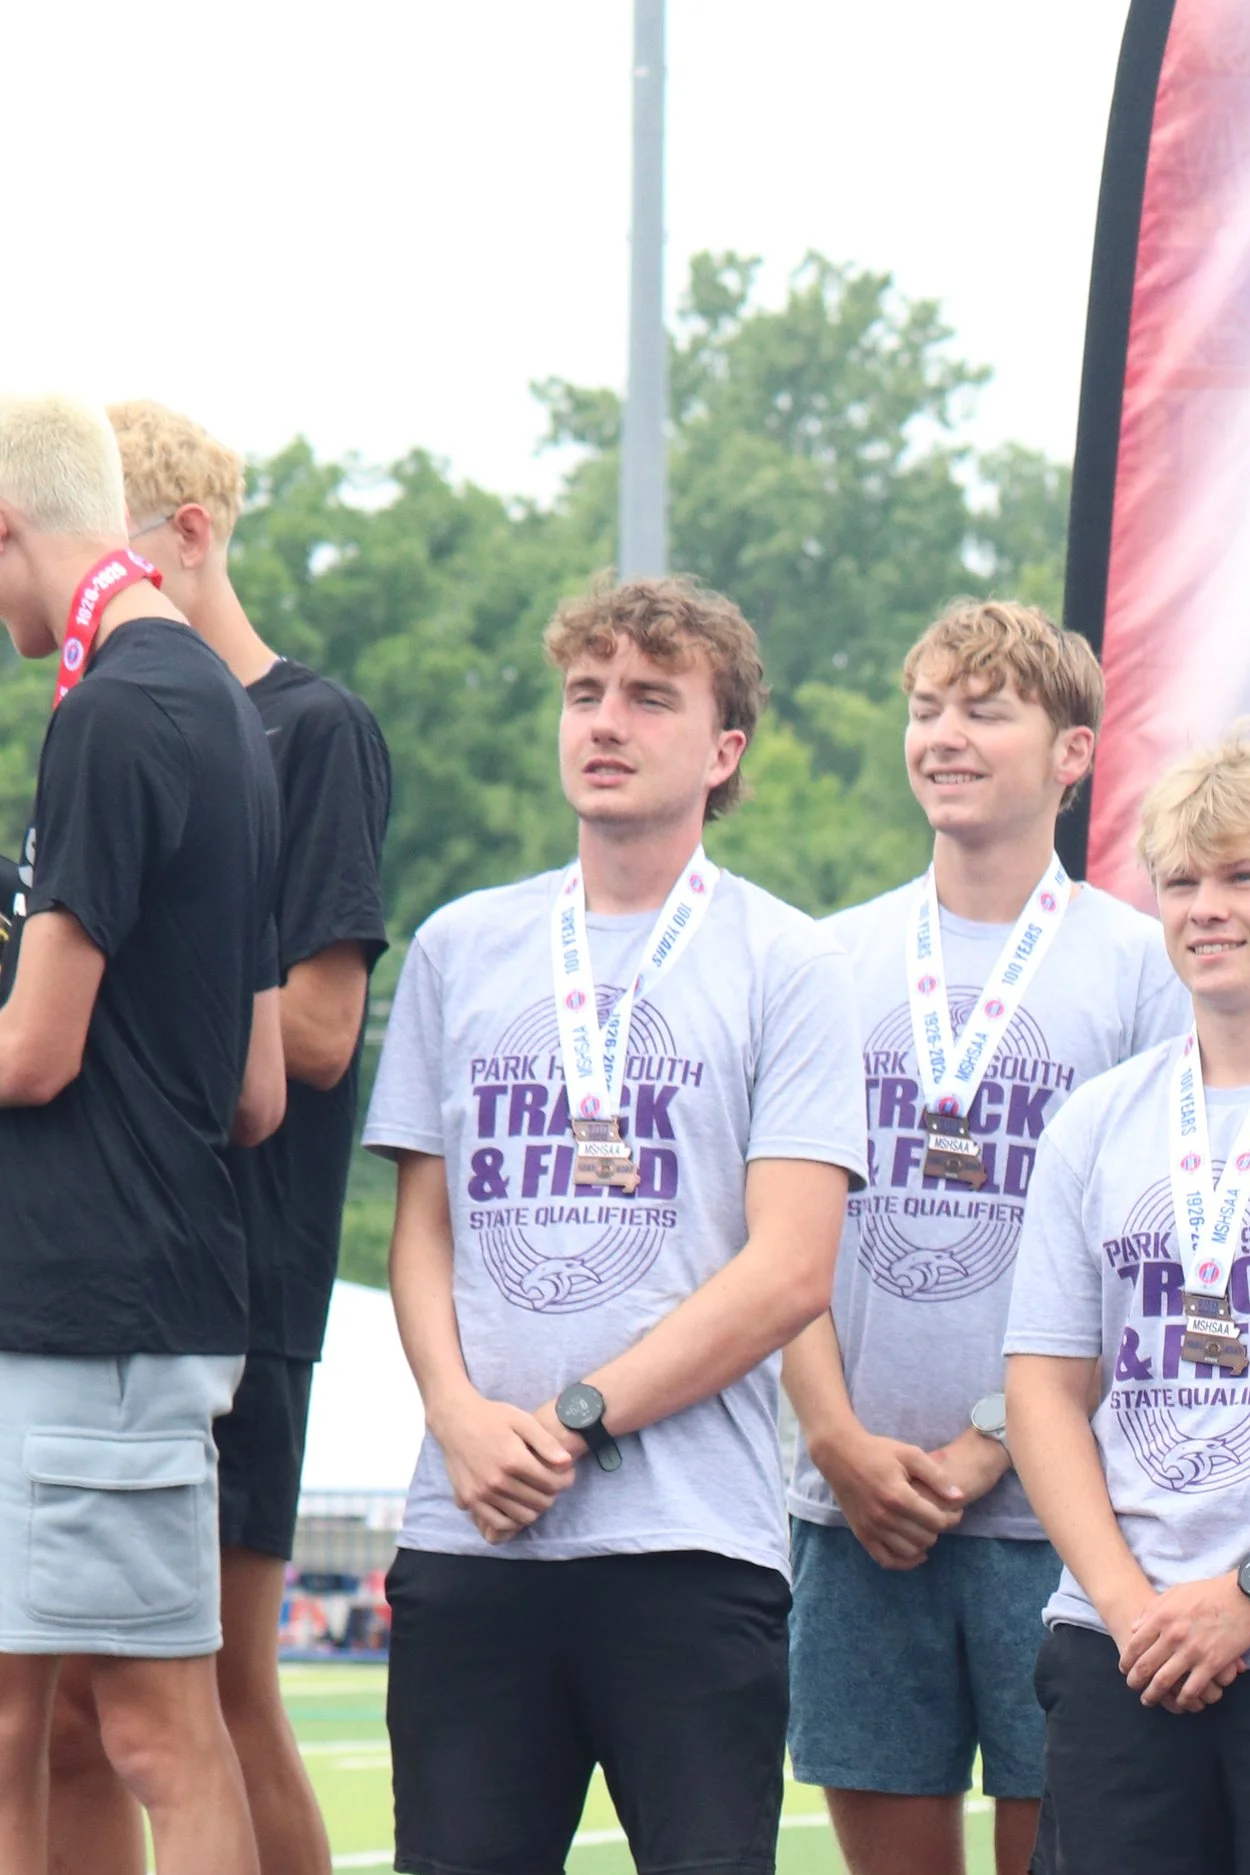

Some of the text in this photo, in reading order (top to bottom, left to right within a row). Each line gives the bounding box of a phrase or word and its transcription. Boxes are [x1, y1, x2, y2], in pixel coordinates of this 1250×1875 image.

[1002, 922, 1043, 987] 100 YEARS
[470, 1055, 540, 1085] PARK
[625, 1055, 704, 1088] OUTH
[954, 1031, 990, 1083] MSHSAA
[1181, 1094, 1197, 1137] YEARS
[467, 1146, 510, 1203] &
[469, 1205, 678, 1231] STATE QUALIFIERS
[1212, 1187, 1241, 1245] MSHSAA
[1102, 1231, 1172, 1268] PARK
[1193, 1319, 1230, 1336] MSHSAA
[1110, 1388, 1175, 1411] STATE
